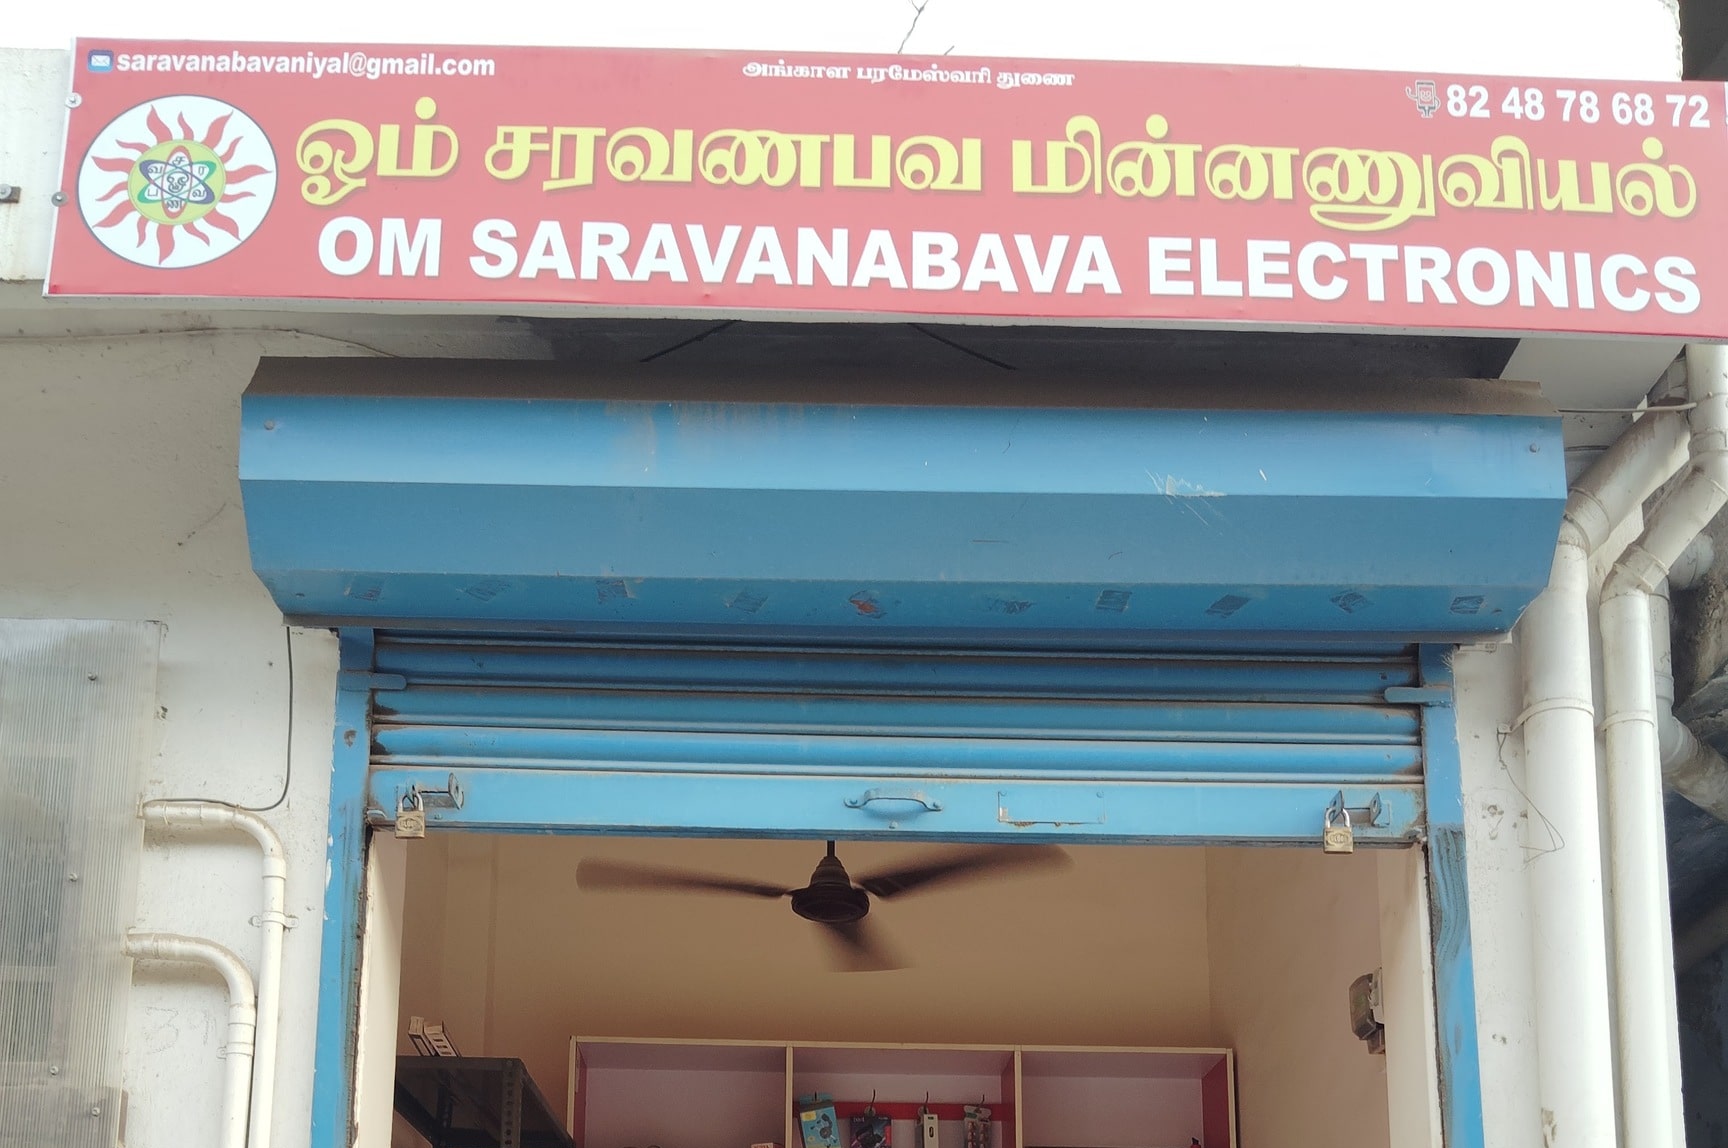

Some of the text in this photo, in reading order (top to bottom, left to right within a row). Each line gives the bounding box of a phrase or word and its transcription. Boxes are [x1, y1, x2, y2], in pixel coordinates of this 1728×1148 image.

[116, 51, 496, 79] saravanabavaniyal@gmail.com
[743, 59, 1075, 89] அங்காள பரமேஸ்வரி துணை
[1446, 83, 1711, 128] 82 48 78 68 72
[484, 126, 982, 191] சரவணபவ
[1012, 114, 1698, 232] மின்னணுவியல்
[318, 216, 1701, 314] OM SARAVANABAVA ELECTRONICS
